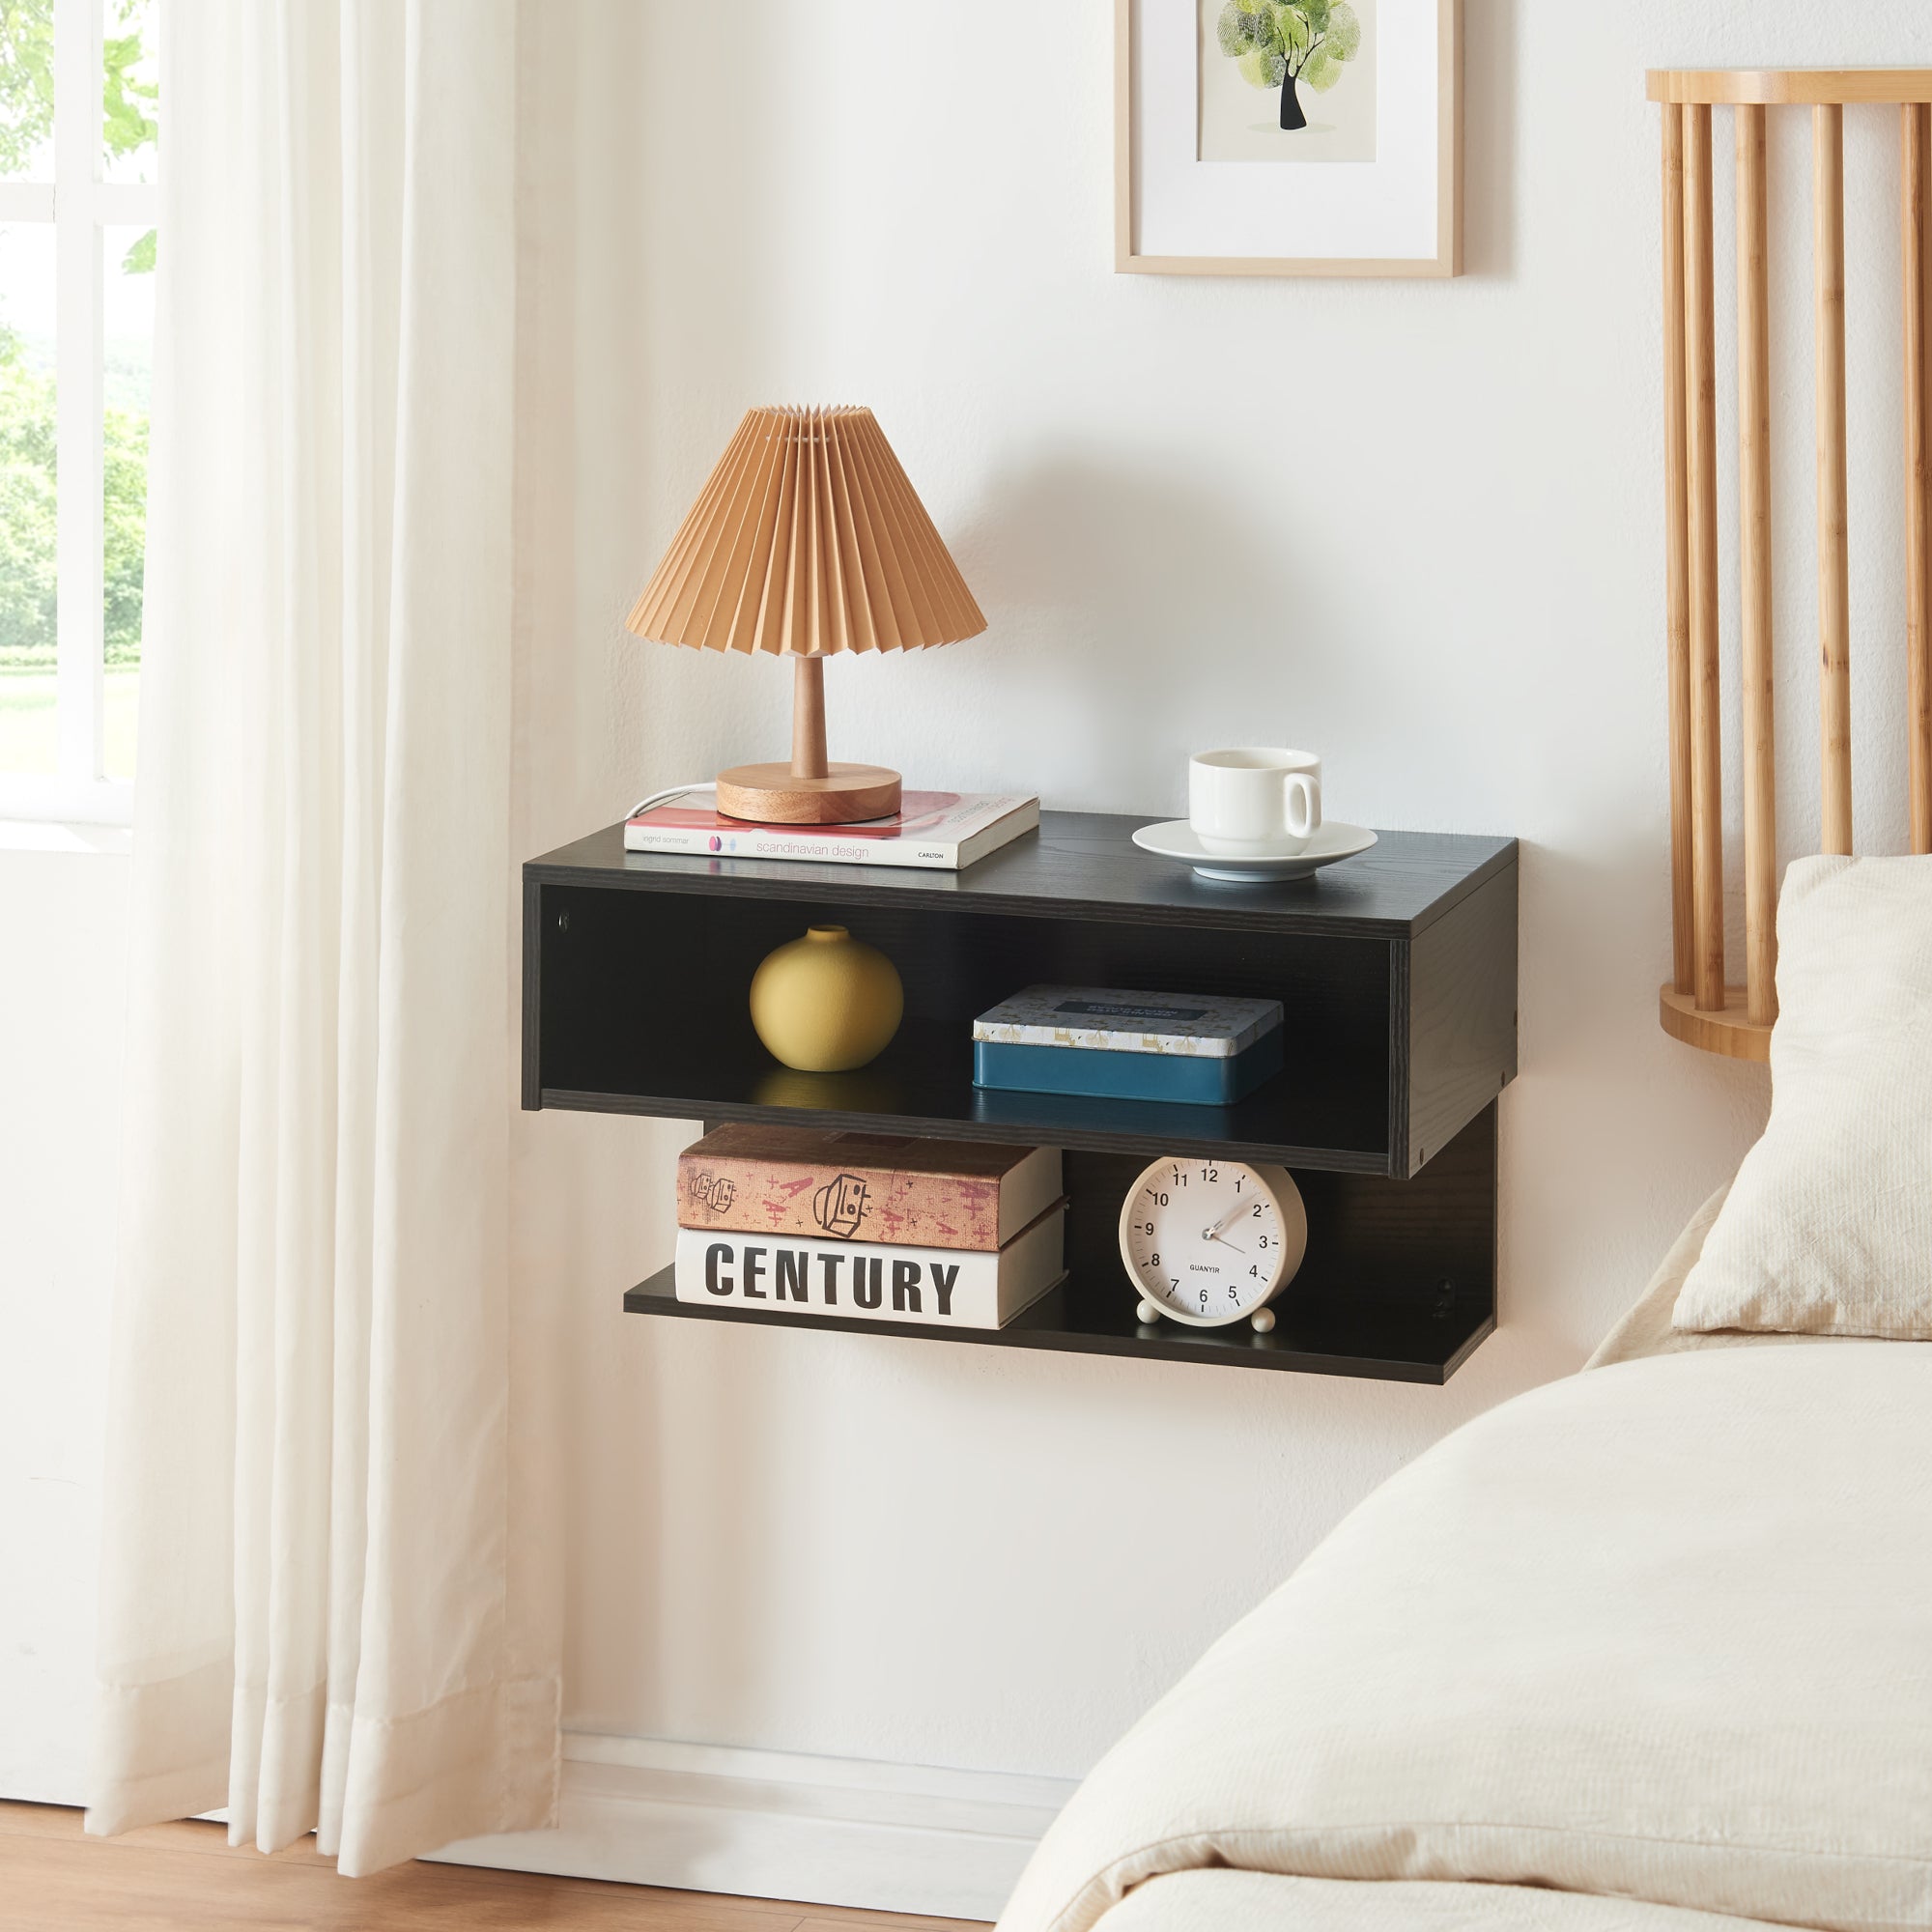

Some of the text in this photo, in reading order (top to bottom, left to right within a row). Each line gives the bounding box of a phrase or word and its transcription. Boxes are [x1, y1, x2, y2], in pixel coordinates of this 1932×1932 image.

[642, 835, 661, 843] ingrid
[756, 841, 869, 860] scandinavian design
[1173, 1173, 1188, 1187] 11
[1201, 1168, 1218, 1182] 12
[1235, 1179, 1240, 1193] 1
[1152, 1192, 1169, 1207] 10
[1252, 1204, 1262, 1217] 2
[1145, 1222, 1154, 1236] 9
[1259, 1235, 1268, 1249] 3
[1151, 1253, 1160, 1266] 8
[1189, 1264, 1220, 1274] GUANYIR
[1249, 1264, 1258, 1277] 4
[704, 1242, 960, 1316] CENTURY
[1170, 1278, 1179, 1292] 7
[1199, 1289, 1208, 1302] 6
[1228, 1286, 1237, 1298] 5
